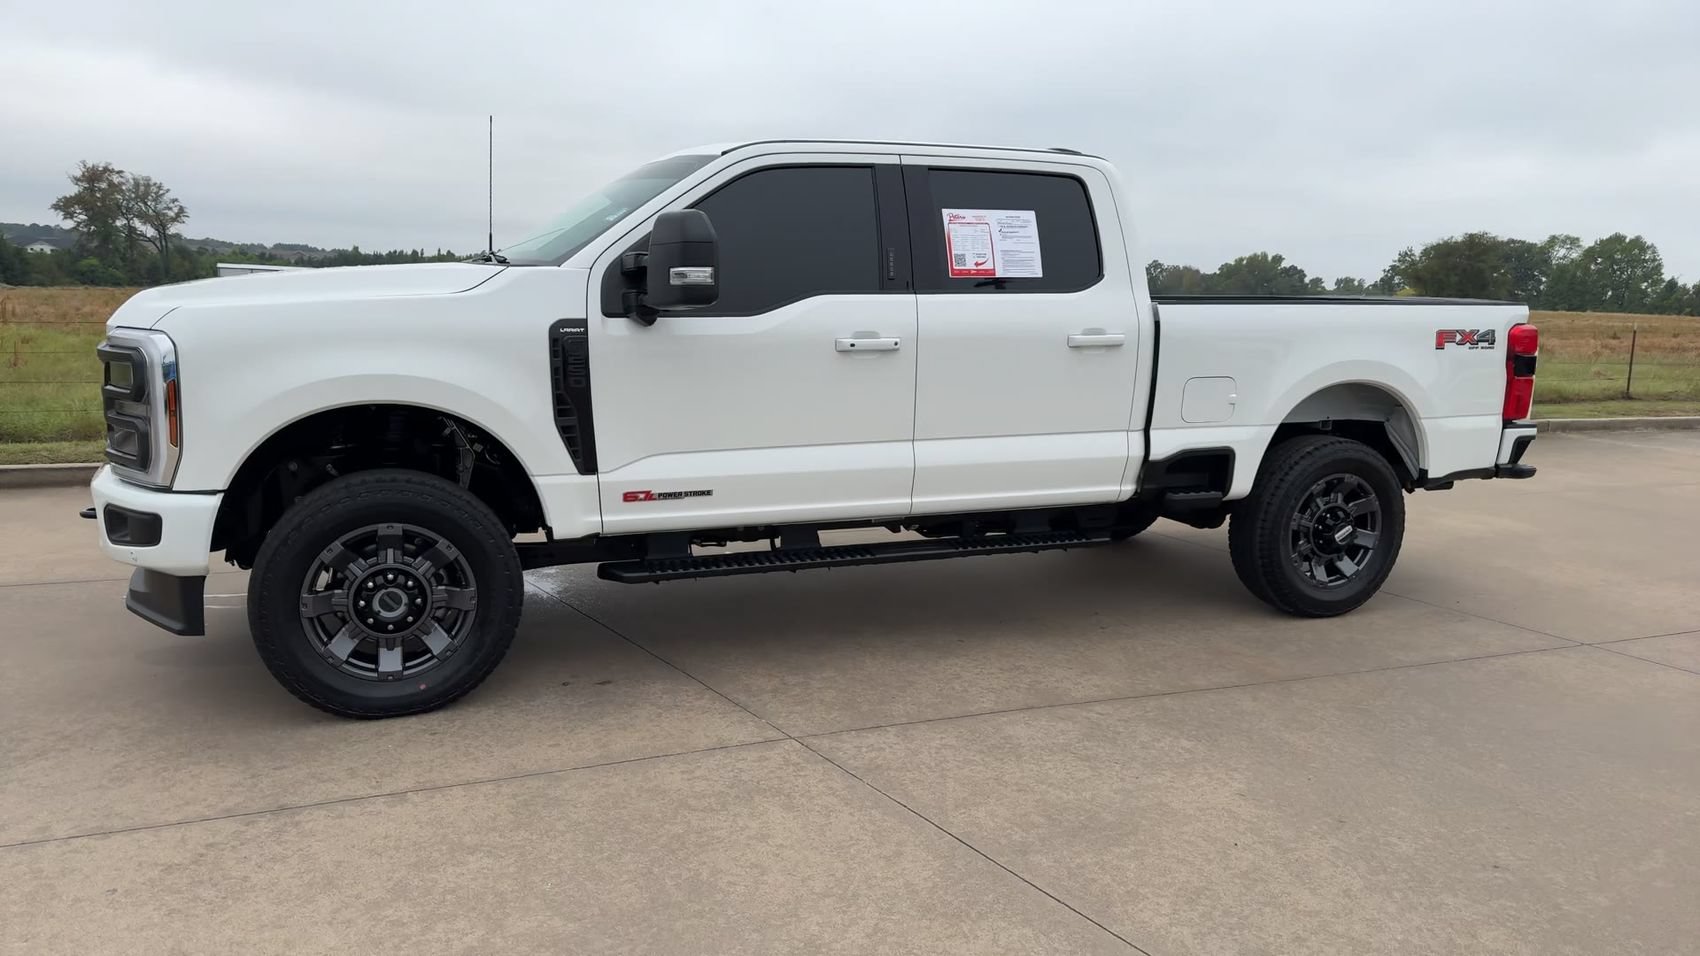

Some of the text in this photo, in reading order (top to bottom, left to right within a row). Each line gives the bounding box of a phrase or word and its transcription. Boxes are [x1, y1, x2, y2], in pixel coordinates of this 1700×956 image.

[1435, 329, 1496, 350] FX4
[658, 491, 683, 499] POWER
[683, 489, 712, 497] STROKE
